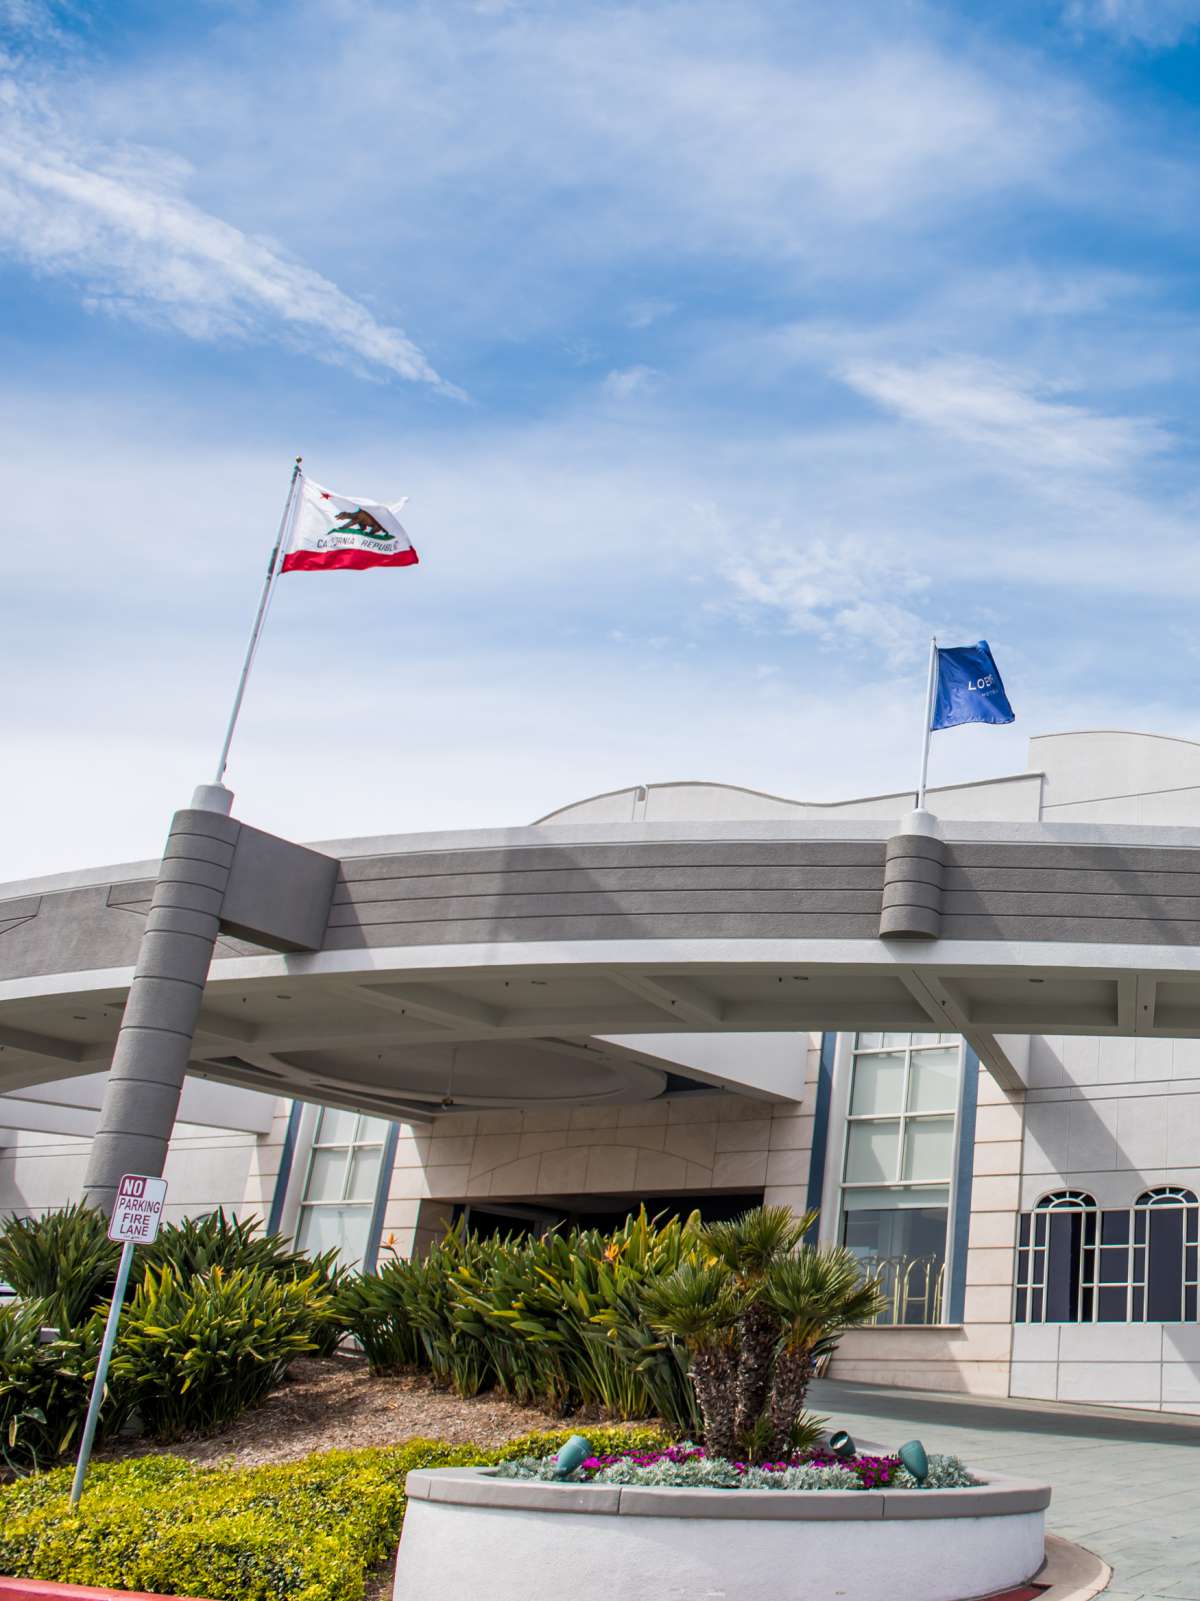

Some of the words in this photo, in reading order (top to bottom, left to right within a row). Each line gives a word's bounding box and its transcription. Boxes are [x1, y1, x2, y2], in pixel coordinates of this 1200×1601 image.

[317, 537, 355, 548] CAORNIA
[122, 1179, 143, 1196] NO
[118, 1198, 161, 1214] PARKING
[122, 1213, 151, 1226] FIRE
[119, 1224, 149, 1237] LANE
